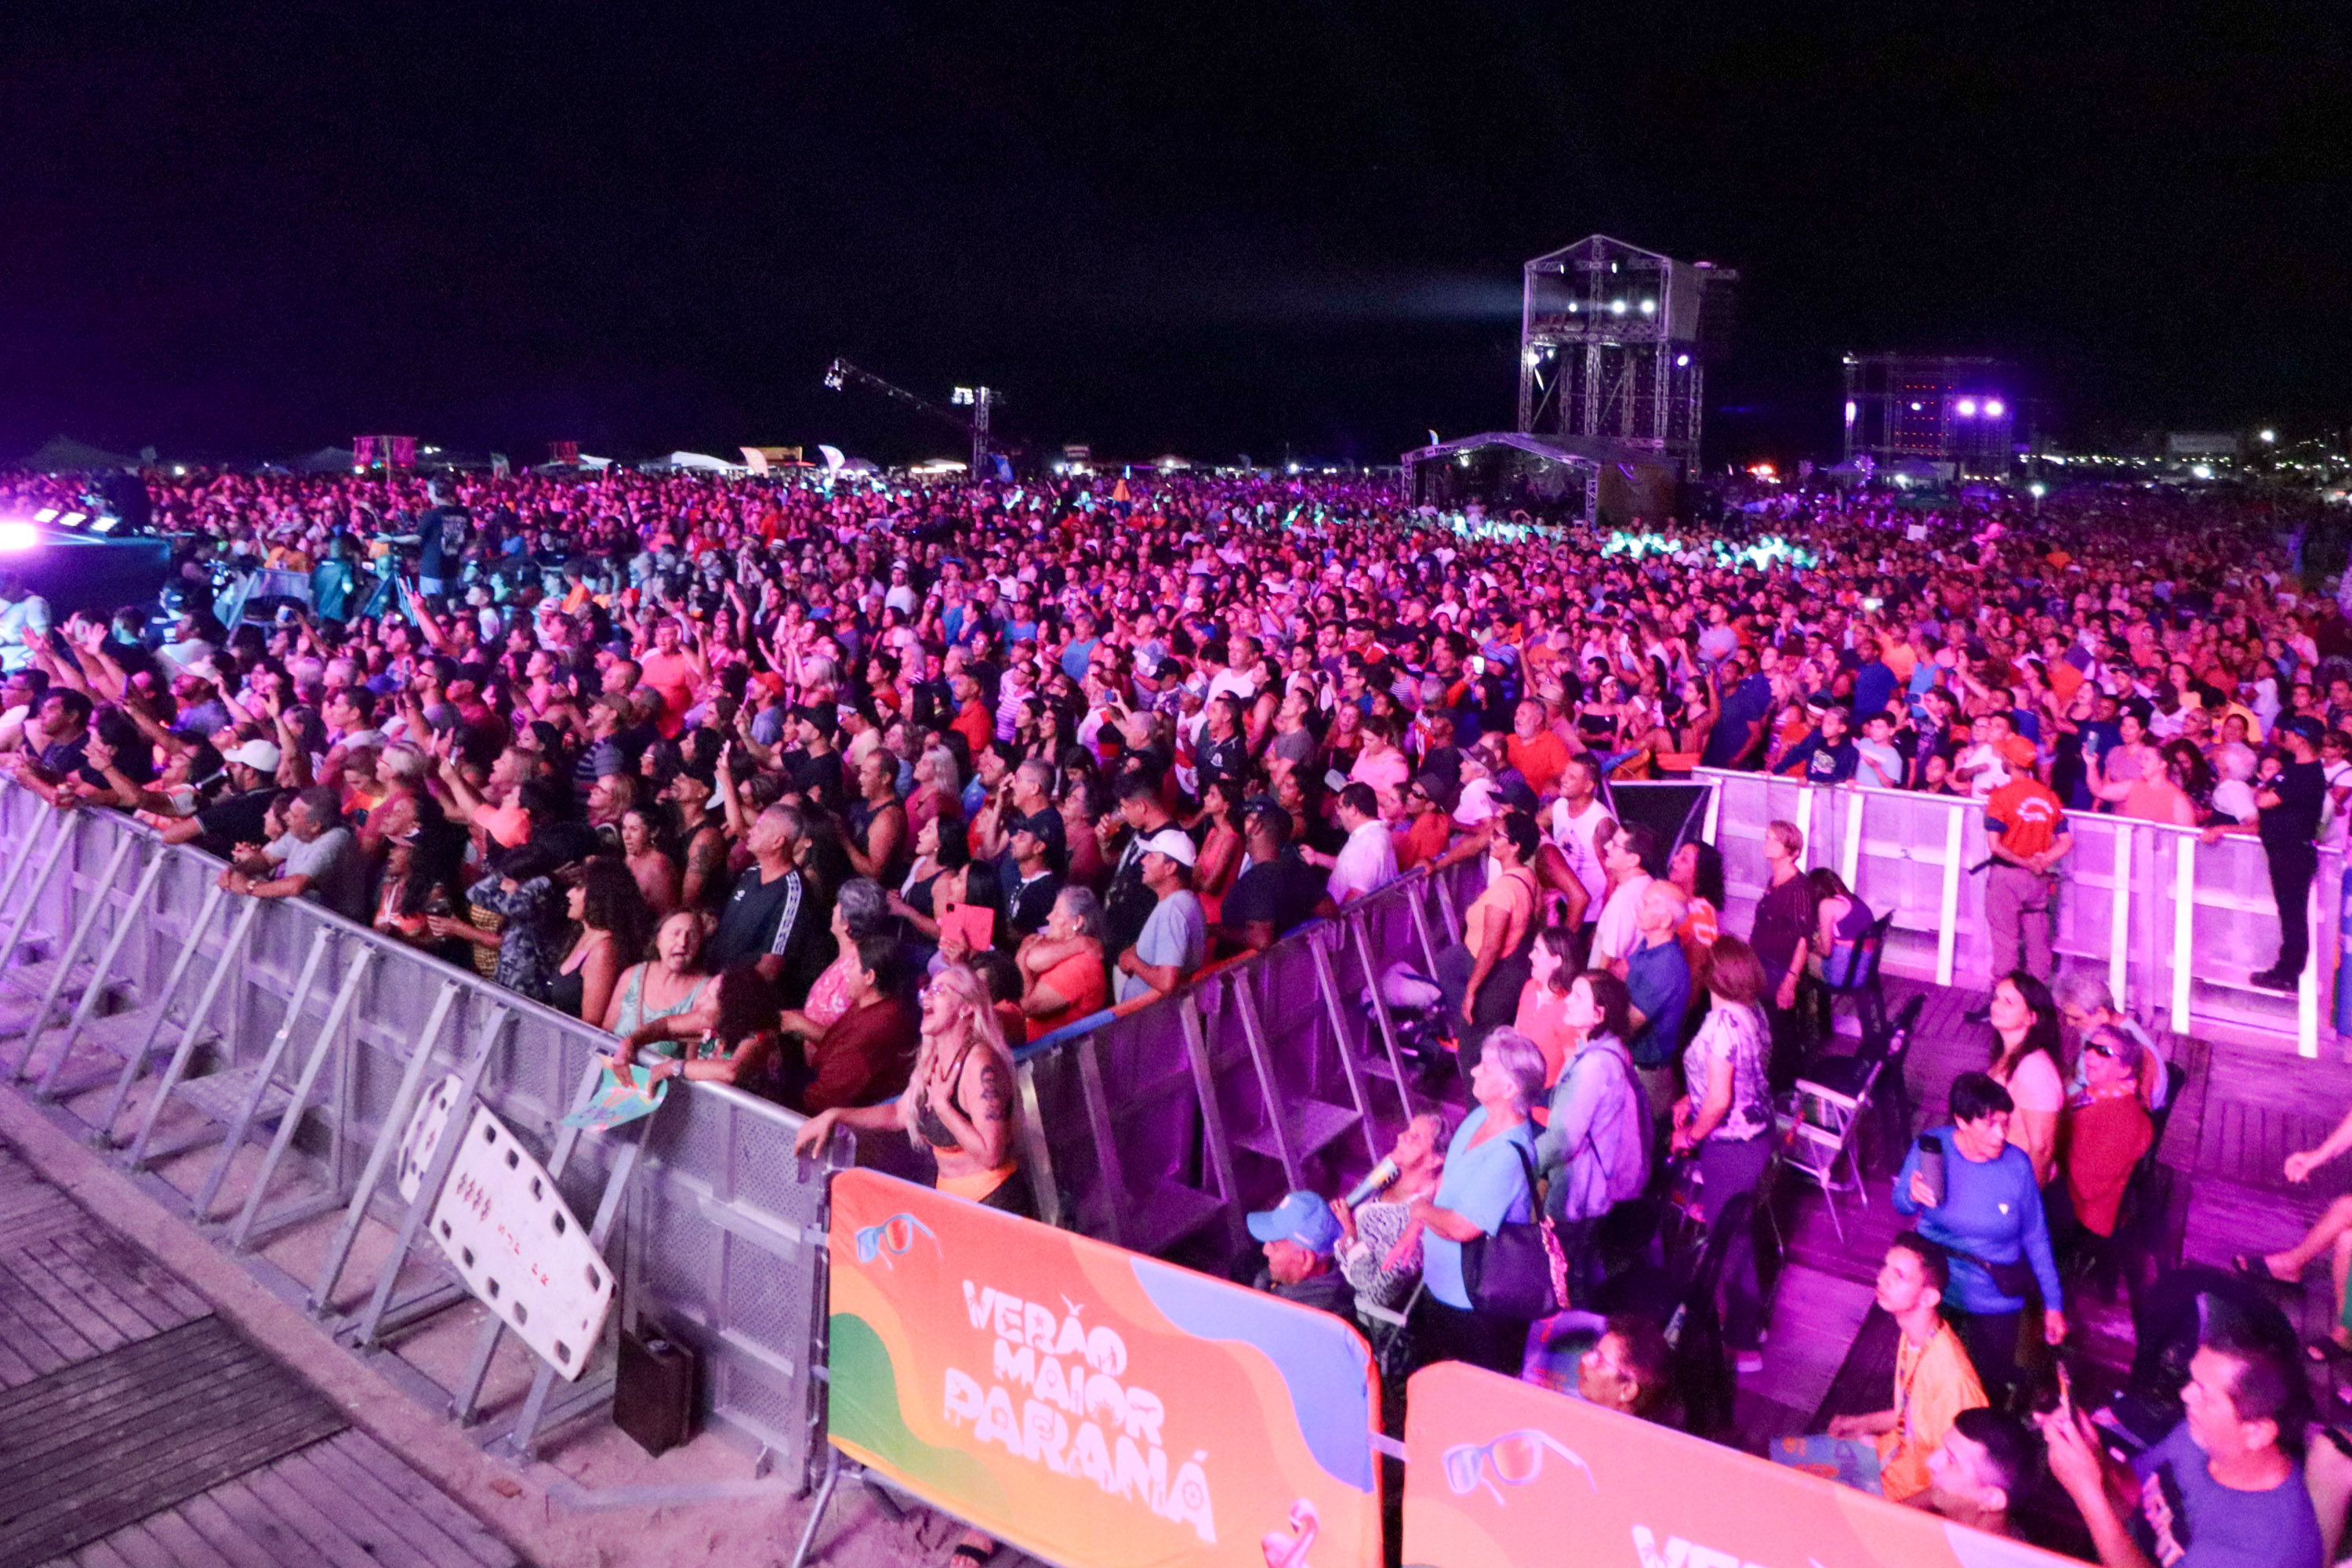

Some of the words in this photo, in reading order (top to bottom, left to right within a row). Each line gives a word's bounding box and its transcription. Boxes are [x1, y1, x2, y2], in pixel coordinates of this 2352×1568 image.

[962, 1279, 1128, 1377] VERÃO
[993, 1338, 1165, 1446] MAIOR
[944, 1367, 1217, 1544] PARANÁ
